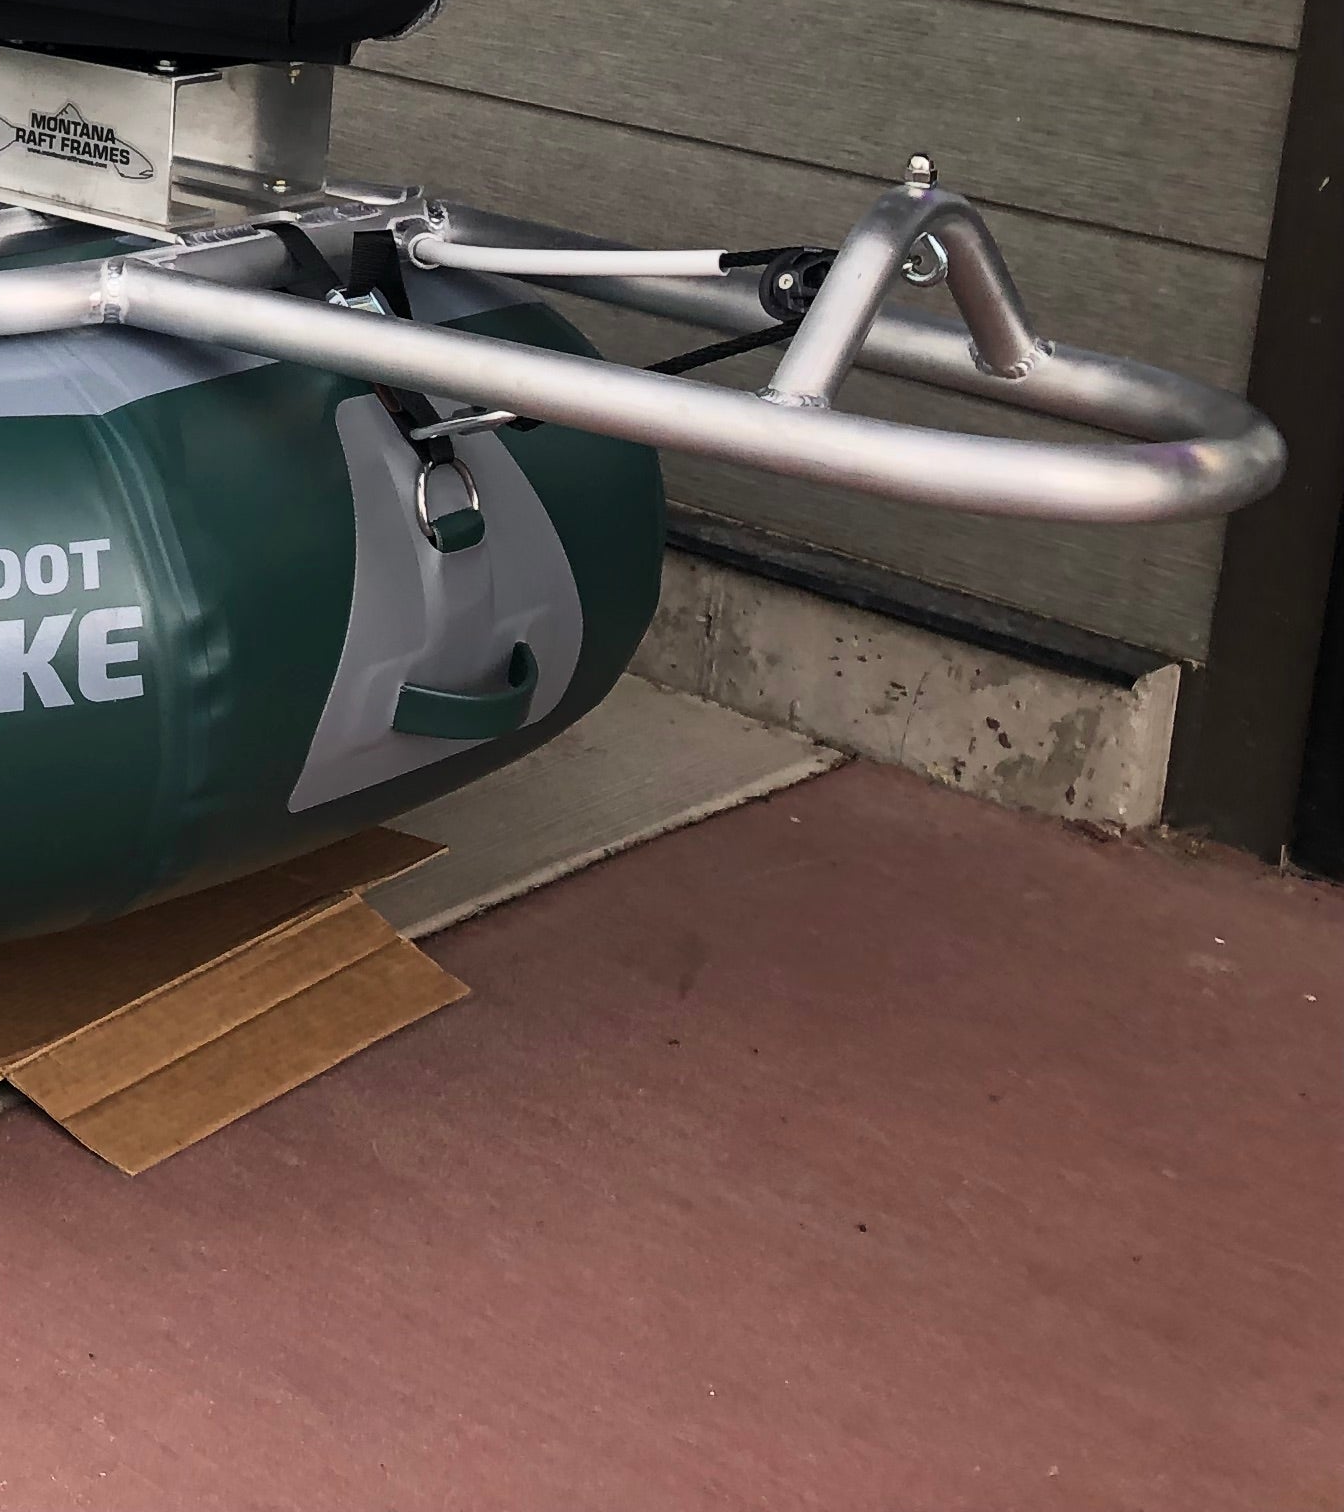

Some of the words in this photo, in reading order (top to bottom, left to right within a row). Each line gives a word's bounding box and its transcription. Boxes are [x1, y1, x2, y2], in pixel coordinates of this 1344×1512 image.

[31, 113, 116, 144] MONTANA
[16, 127, 56, 149] RAFT
[61, 136, 130, 165] FRAMES
